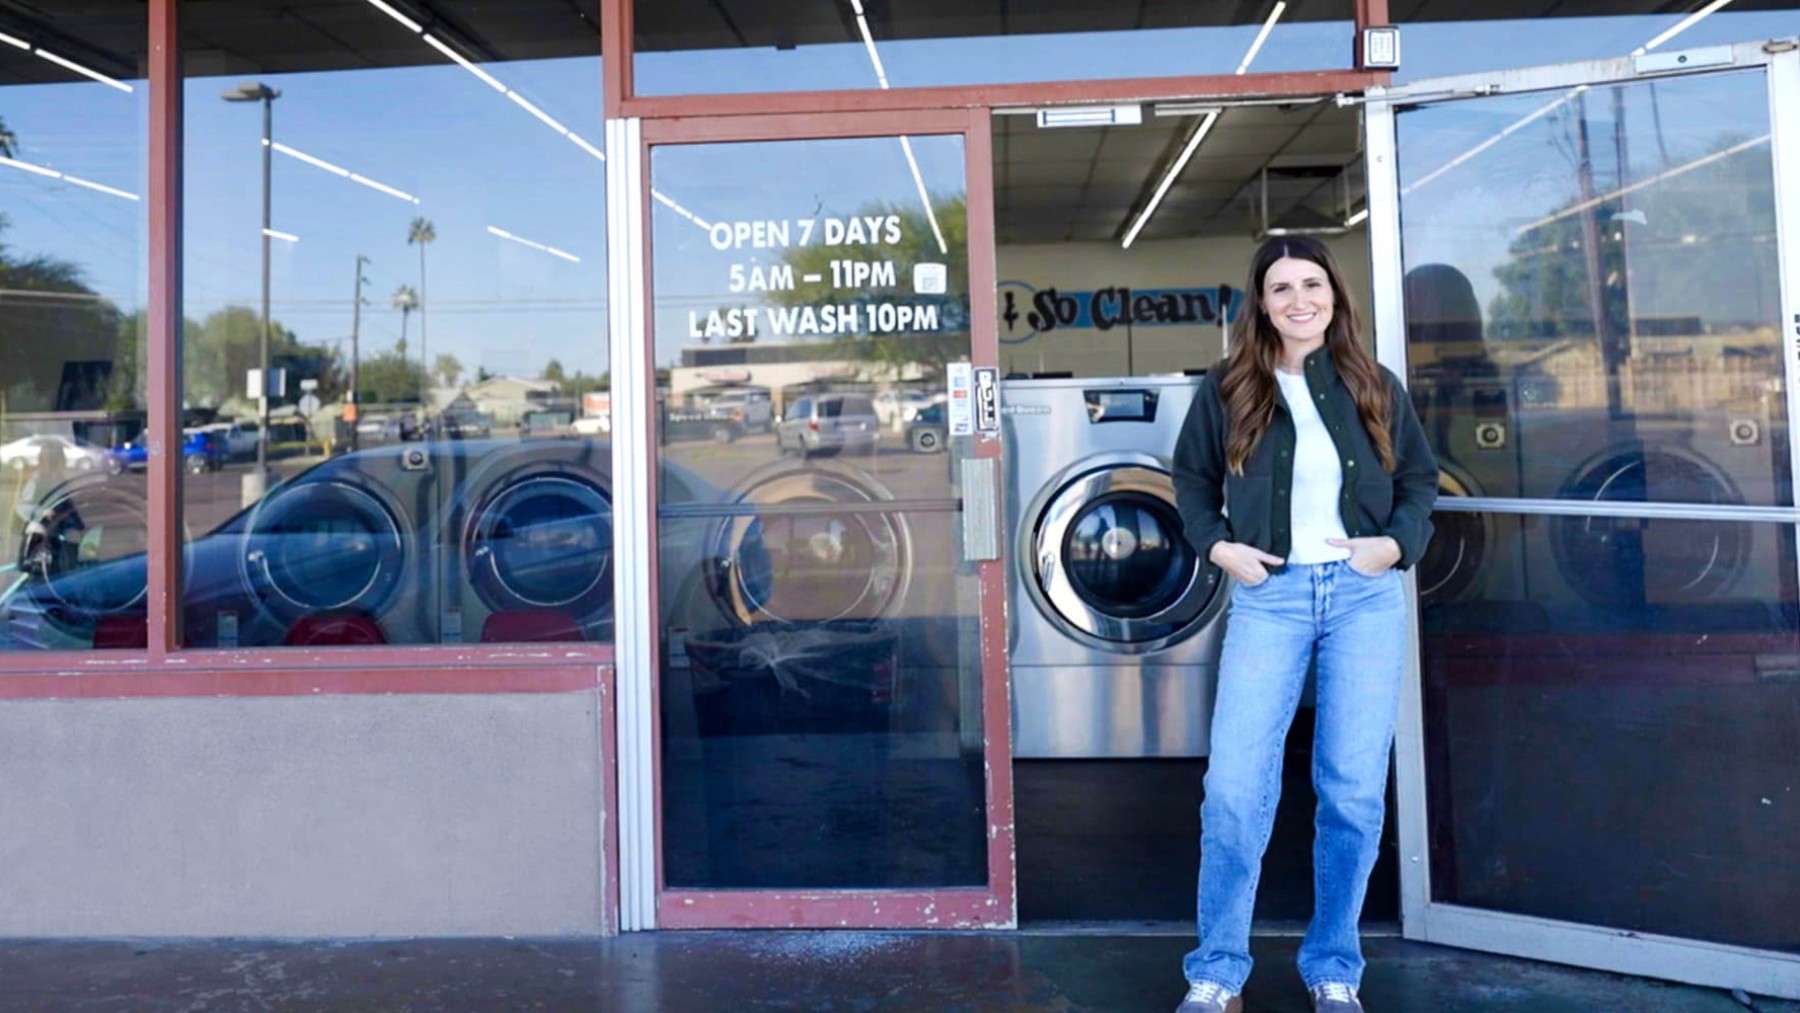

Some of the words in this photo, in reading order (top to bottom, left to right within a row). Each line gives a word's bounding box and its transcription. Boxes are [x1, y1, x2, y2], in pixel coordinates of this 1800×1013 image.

[709, 221, 790, 250] OPEN
[797, 219, 815, 247] 7
[825, 215, 902, 246] DAYS
[728, 264, 795, 292] 5AM
[830, 260, 896, 288] 11PM
[688, 309, 758, 338] LAST
[767, 304, 857, 335] WASH
[867, 302, 938, 332] 10PM
[1027, 286, 1078, 332] So
[1091, 283, 1232, 331] Clean!
